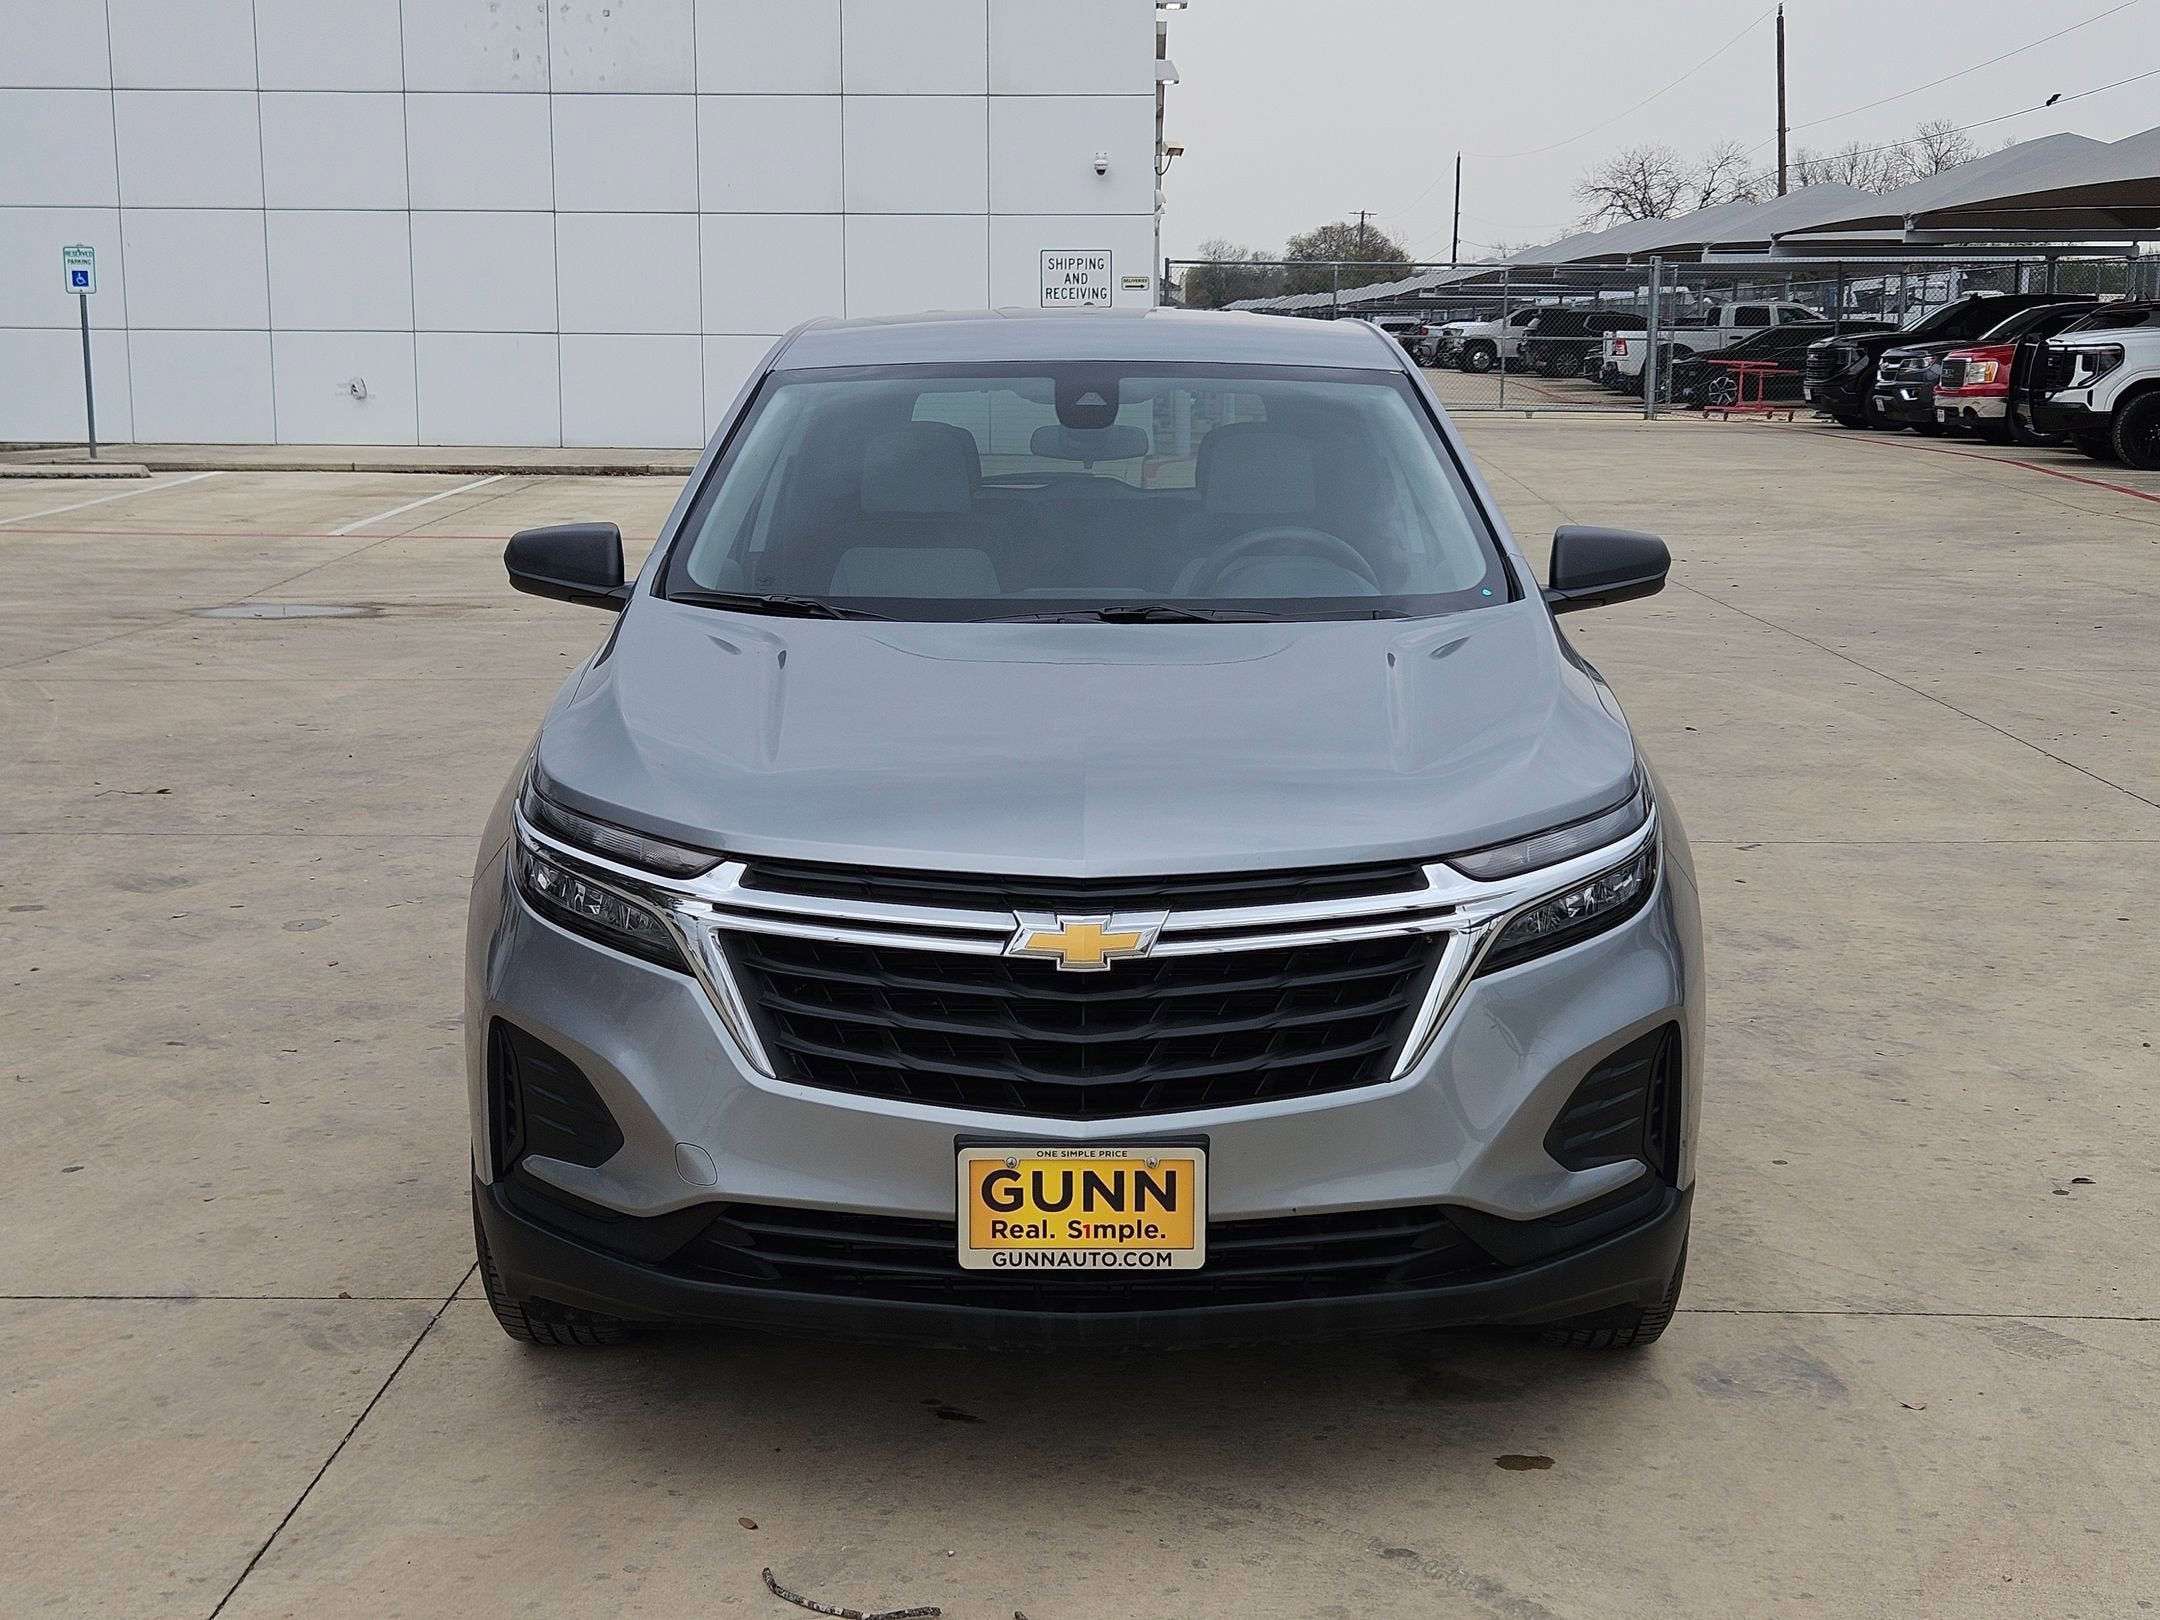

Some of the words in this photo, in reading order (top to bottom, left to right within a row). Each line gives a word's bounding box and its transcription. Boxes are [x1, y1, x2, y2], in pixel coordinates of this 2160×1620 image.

[1048, 258, 1104, 270] SHIPPING
[1064, 272, 1089, 285] AND
[1045, 287, 1107, 299] RECEIVING
[1036, 1150, 1058, 1158] ONE
[1060, 1150, 1096, 1158] SIMPLE
[1098, 1150, 1128, 1158] PRICE
[981, 1169, 1177, 1213] GUNN
[991, 1219, 1056, 1240] Real.
[992, 1251, 1173, 1268] GUNNAUTO.COM
